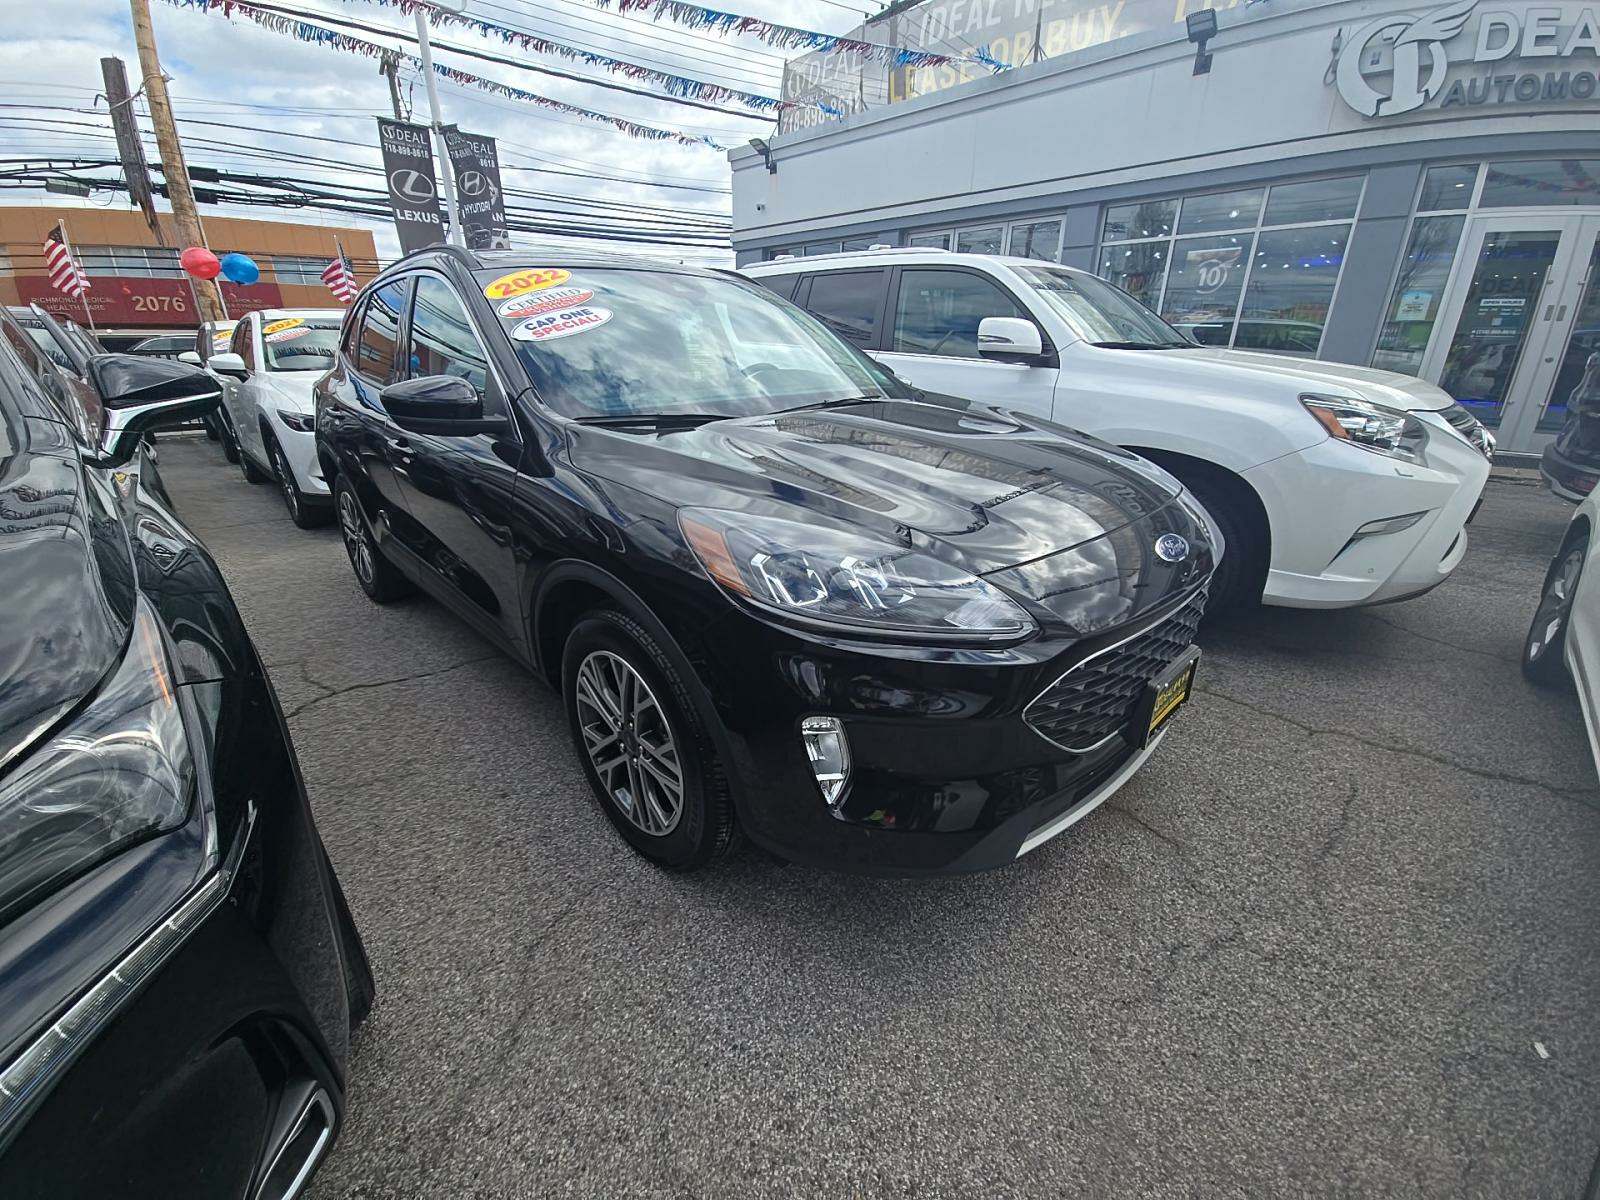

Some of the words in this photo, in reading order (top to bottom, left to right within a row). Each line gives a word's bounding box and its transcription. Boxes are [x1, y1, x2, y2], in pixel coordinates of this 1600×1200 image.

[395, 208, 440, 224] LEXUS
[494, 269, 566, 297] 2022
[131, 296, 186, 312] 2076
[524, 315, 556, 331] CAP
[560, 308, 593, 320] ONE
[532, 315, 602, 338] SPECIAL!
